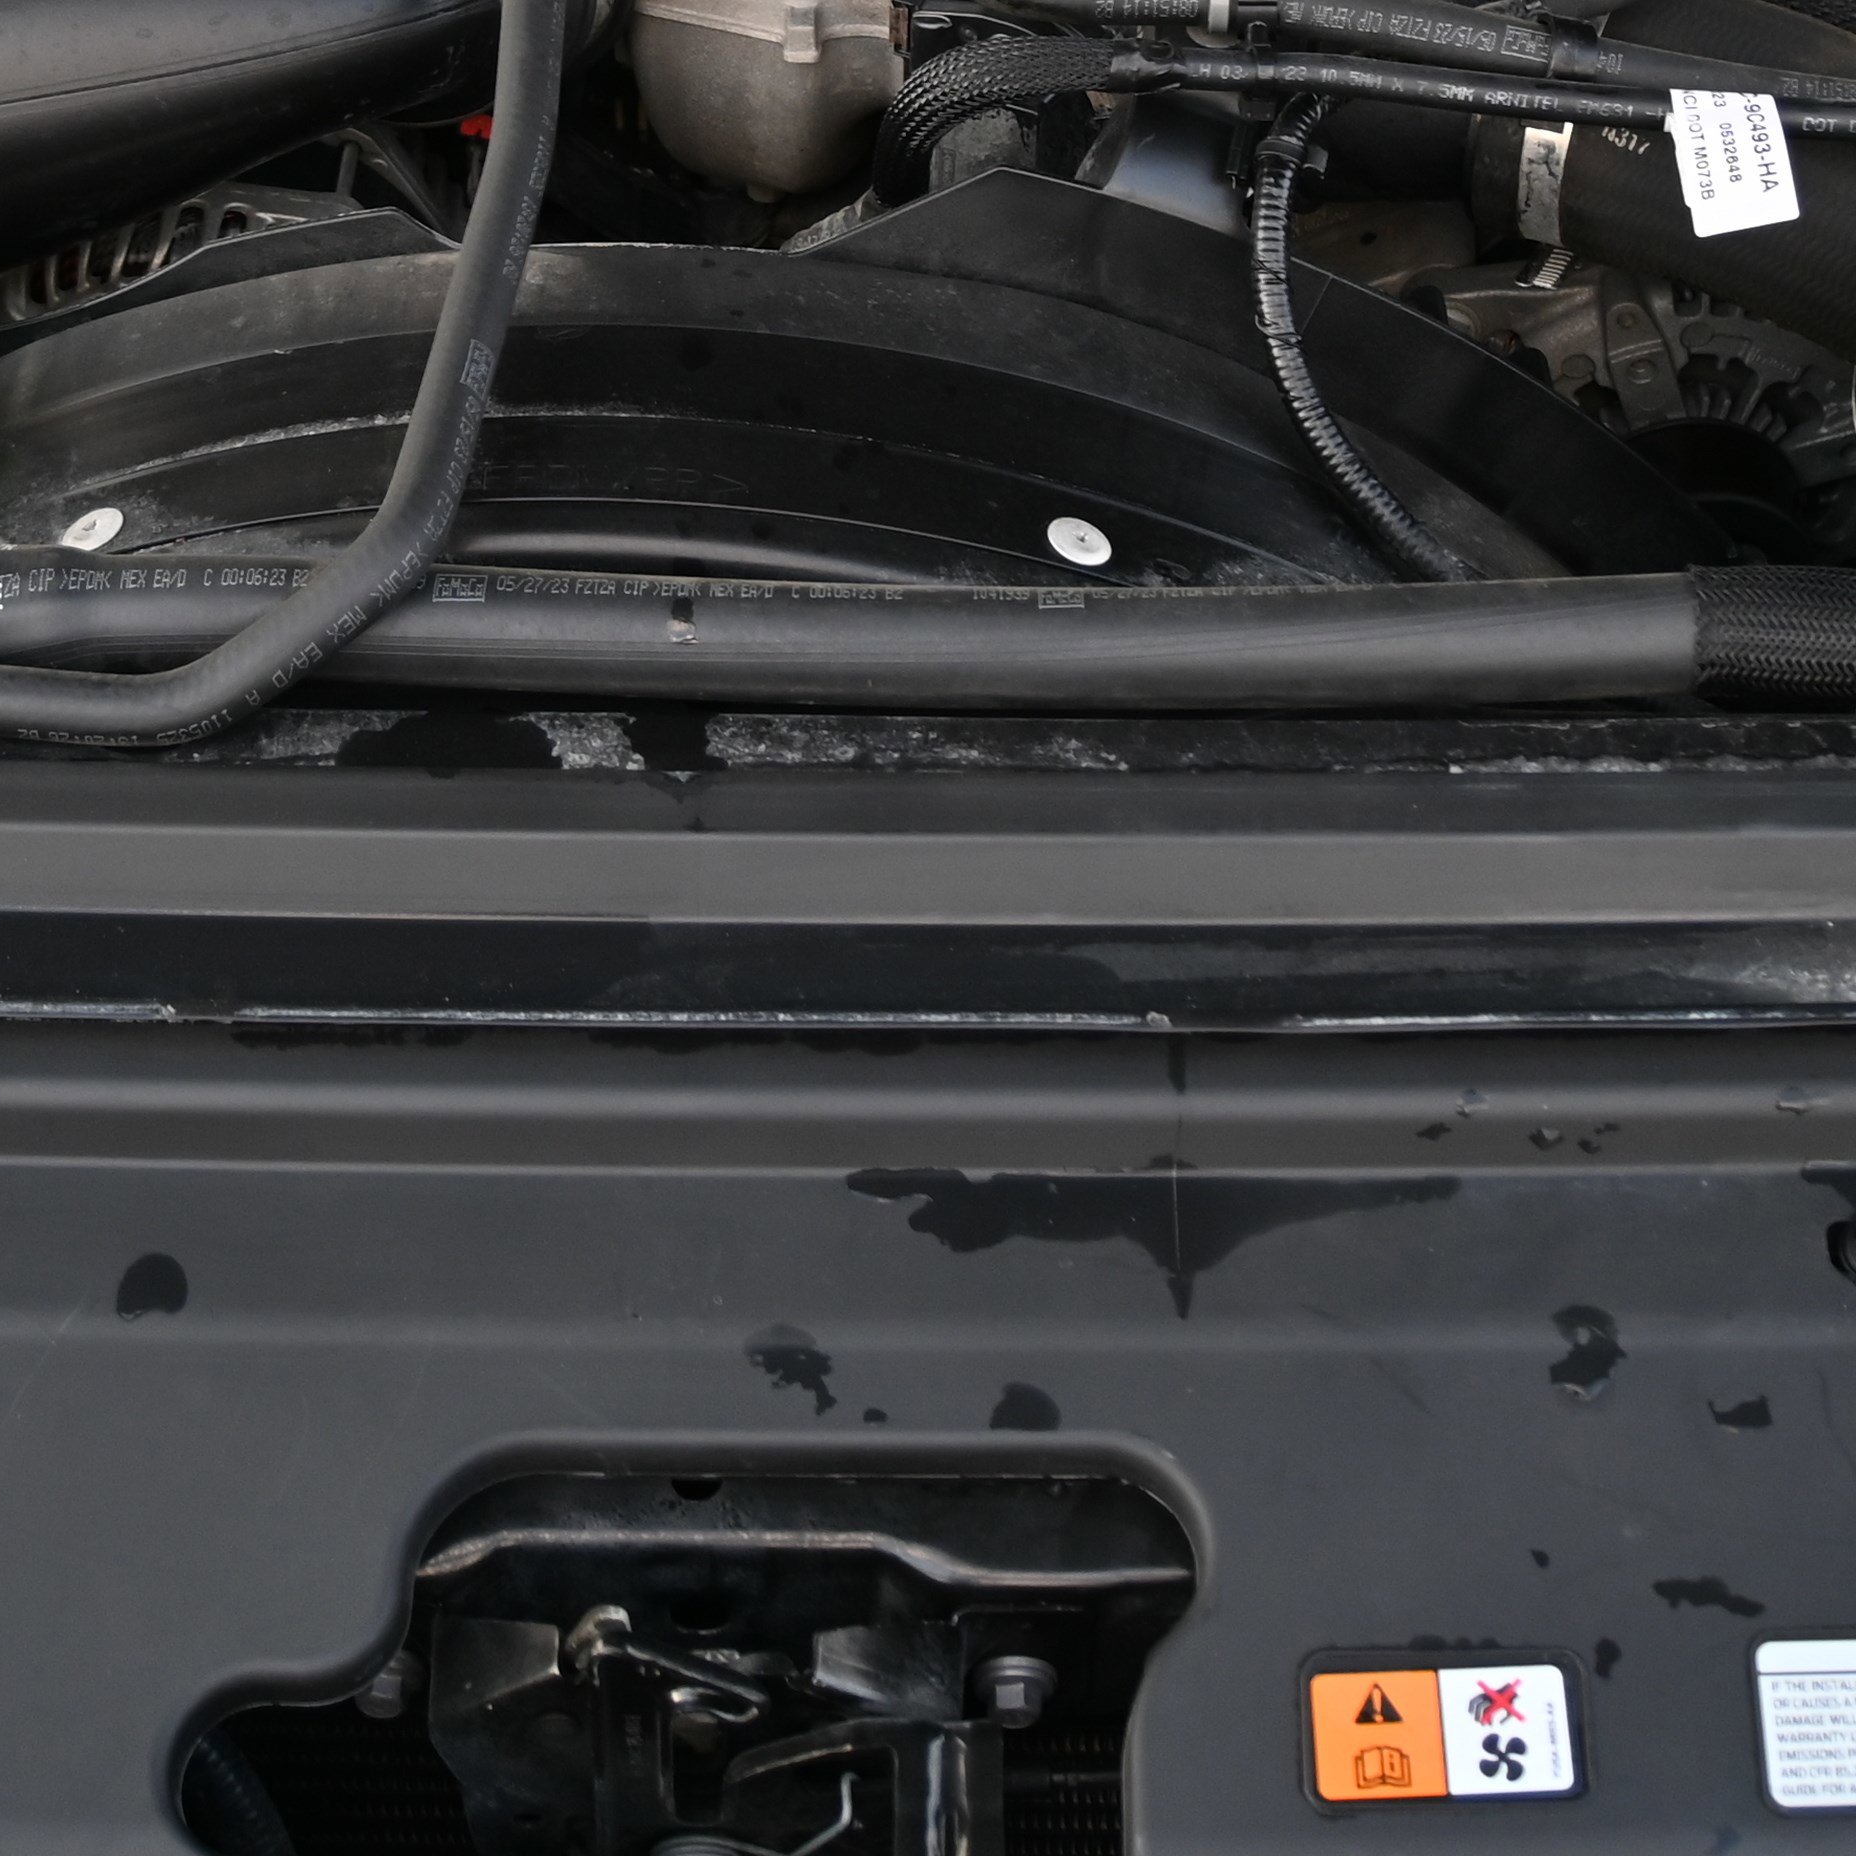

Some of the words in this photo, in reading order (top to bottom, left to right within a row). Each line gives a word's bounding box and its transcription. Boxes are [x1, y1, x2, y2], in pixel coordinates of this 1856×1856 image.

[1484, 90, 1559, 111] ARNITEL
[1742, 94, 1779, 193] -9C493-HA
[29, 571, 54, 591] CIP
[120, 569, 146, 589] MEX
[153, 569, 186, 589] EA/D
[220, 568, 287, 586] 00:06:23
[496, 575, 570, 595] 05/27/23
[624, 580, 649, 596] CIP
[326, 605, 367, 643] MEX
